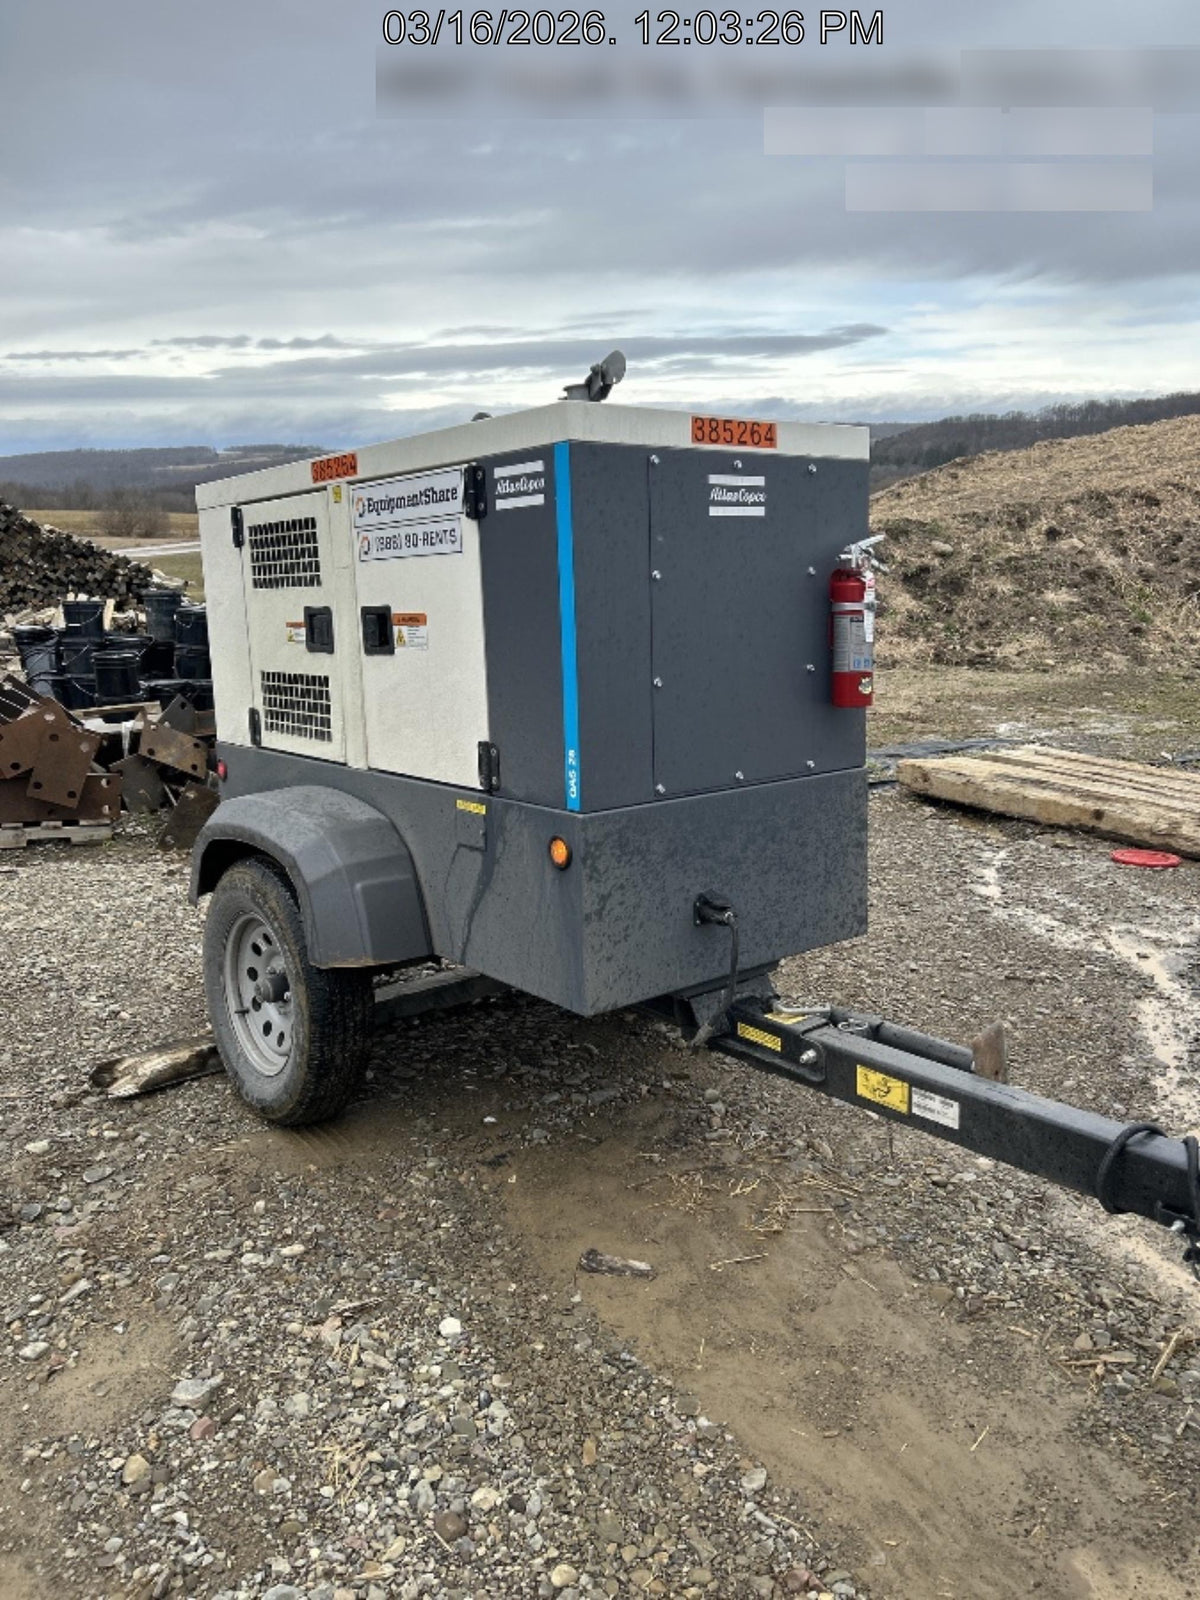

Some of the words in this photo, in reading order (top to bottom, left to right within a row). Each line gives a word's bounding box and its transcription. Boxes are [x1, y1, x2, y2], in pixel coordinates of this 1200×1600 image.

[694, 417, 775, 446] 385264
[311, 453, 357, 483] 385264
[366, 486, 458, 516] EquipmentShare
